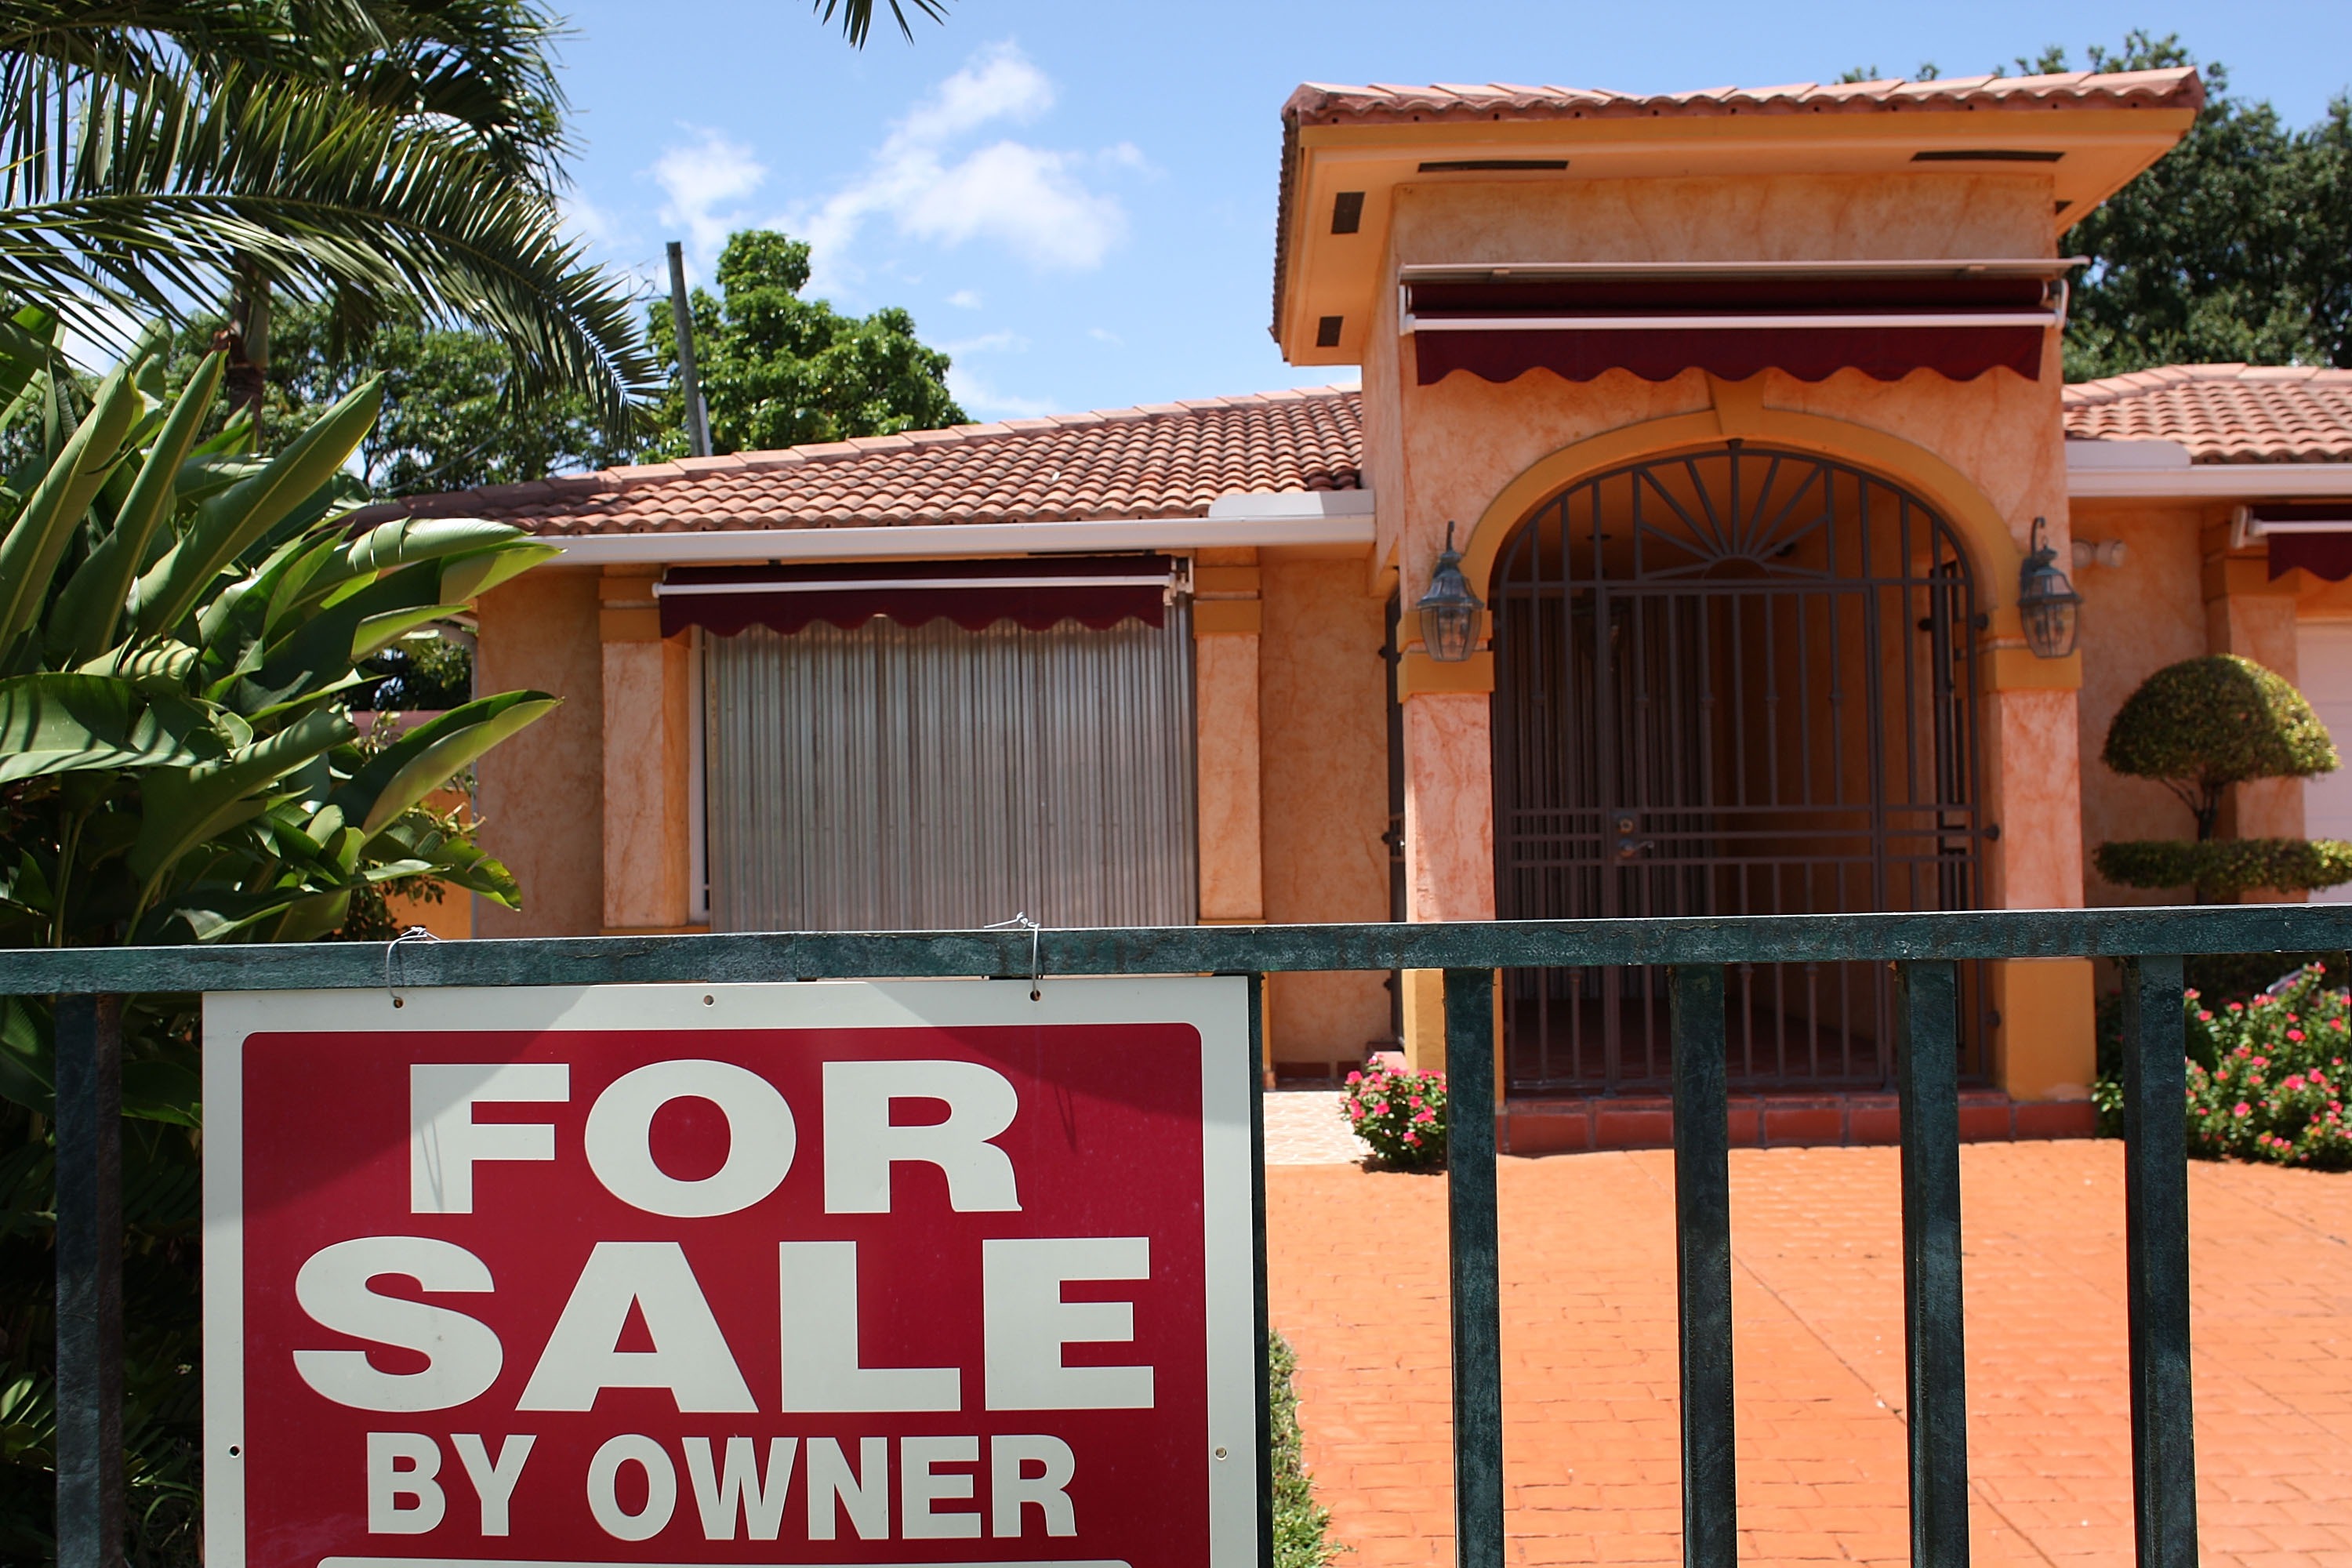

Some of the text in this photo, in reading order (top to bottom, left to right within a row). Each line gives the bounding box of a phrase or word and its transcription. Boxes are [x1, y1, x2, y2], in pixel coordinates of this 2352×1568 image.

[410, 1059, 1022, 1218] FOR
[293, 1236, 1154, 1413] SALE
[367, 1432, 1077, 1541] BY OWNER
